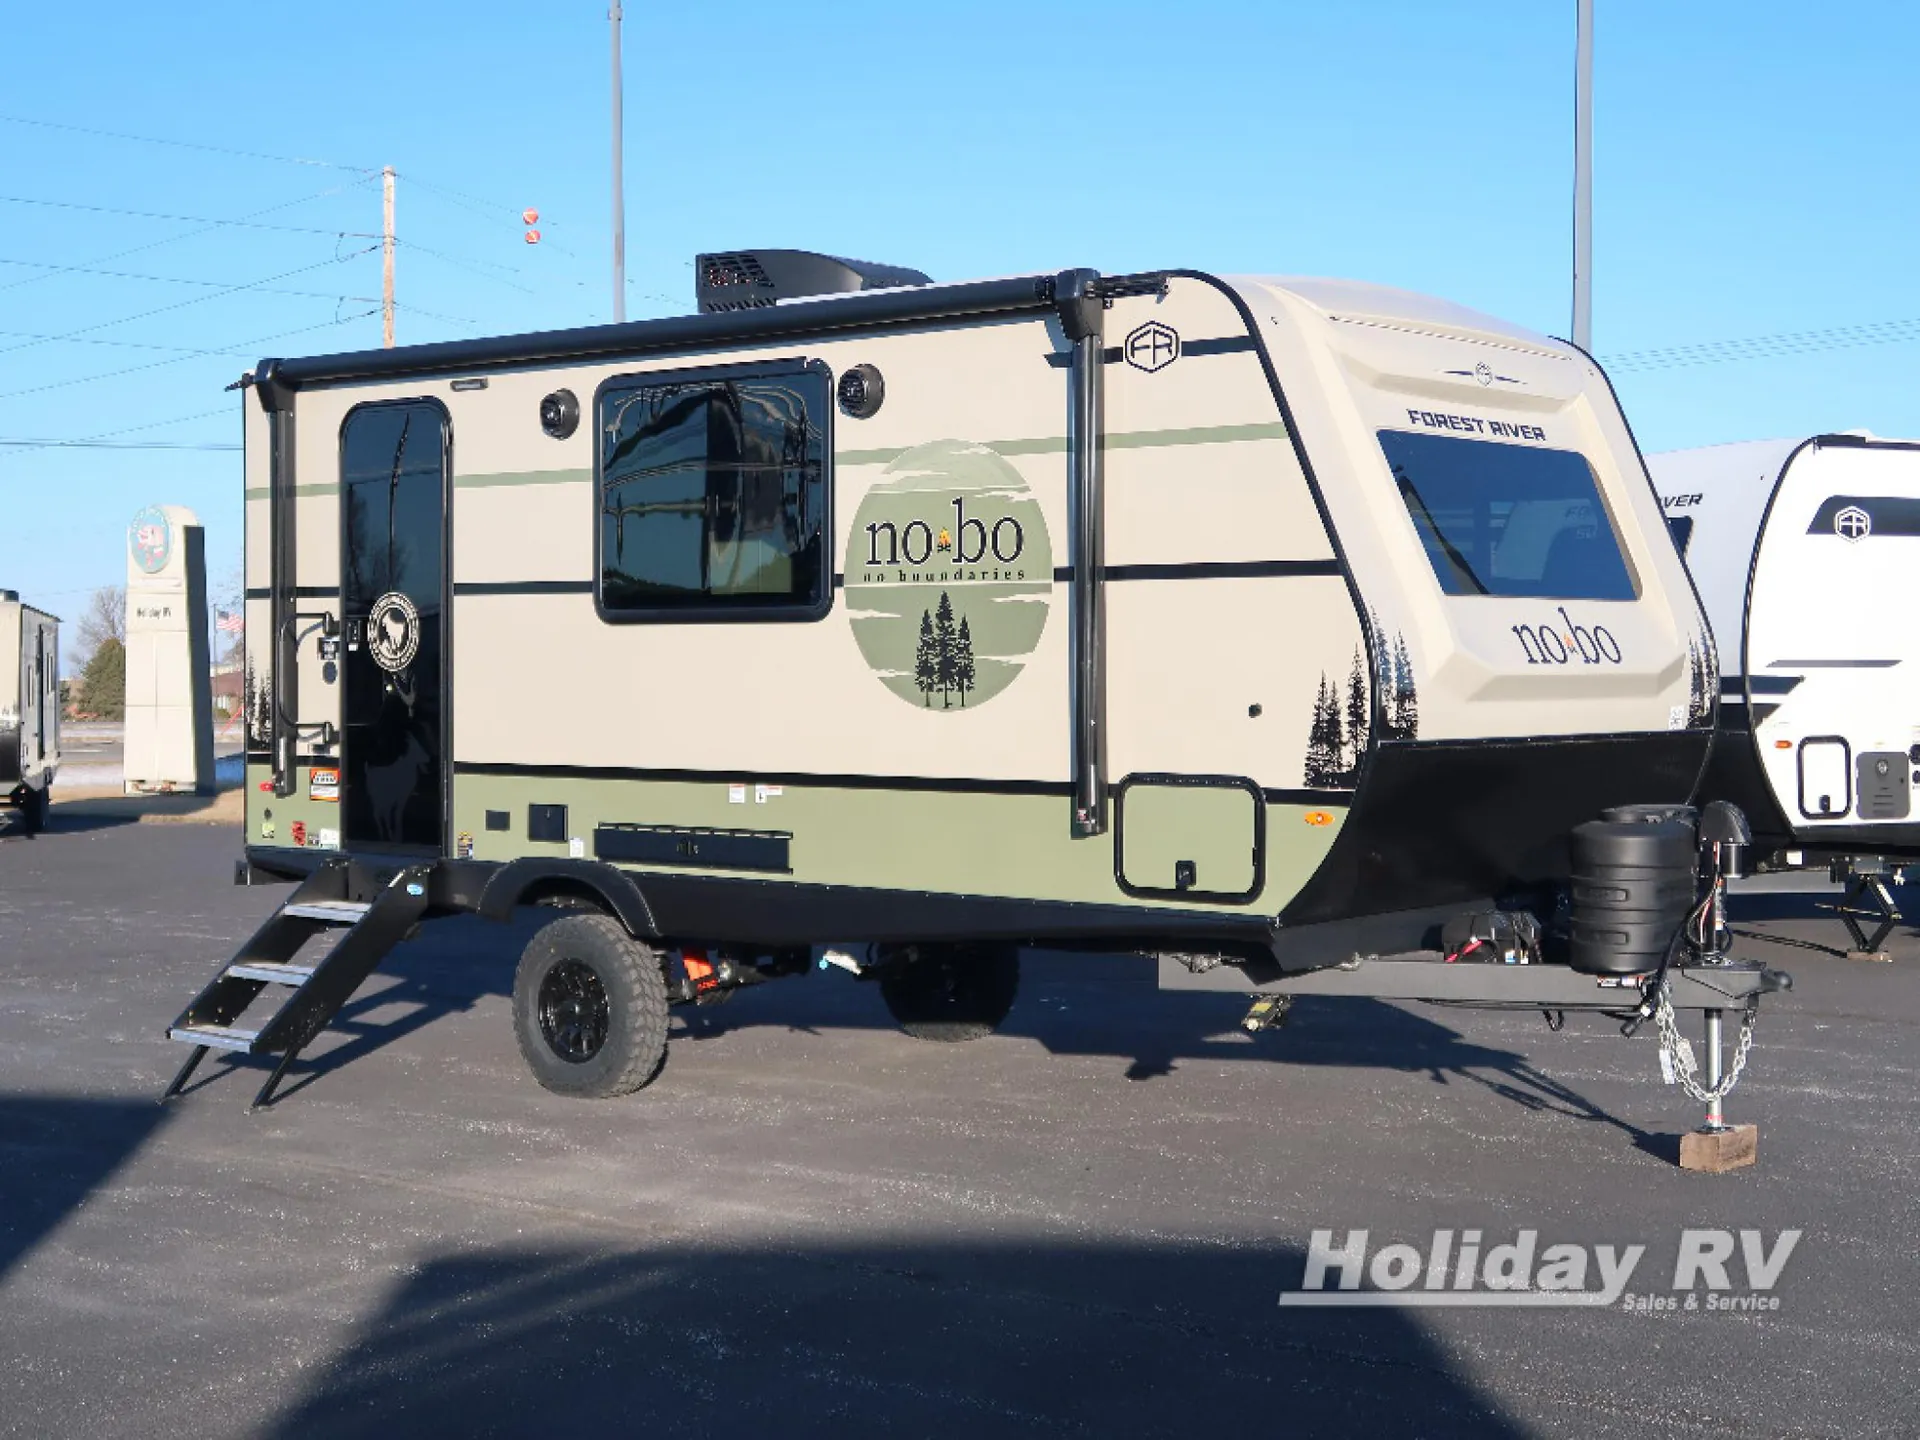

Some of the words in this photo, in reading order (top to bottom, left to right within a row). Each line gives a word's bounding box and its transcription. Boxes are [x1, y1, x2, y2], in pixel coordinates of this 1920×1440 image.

[1406, 409, 1484, 433] FOREST
[1487, 420, 1546, 441] RIVER
[1664, 493, 1703, 508] VER
[898, 568, 1025, 582] boundaries
